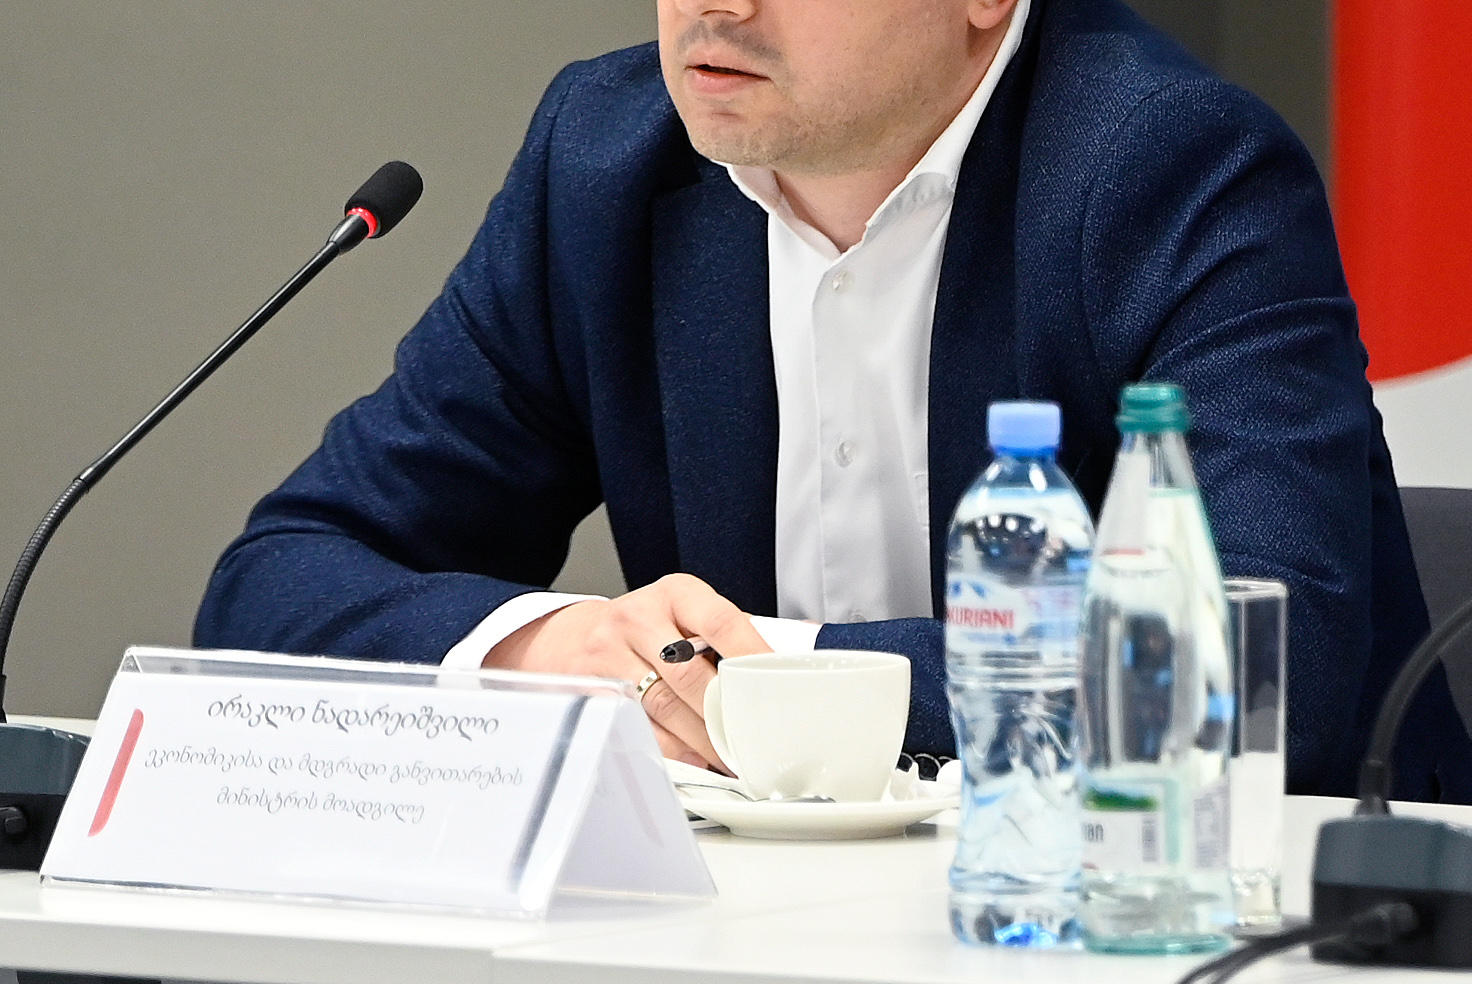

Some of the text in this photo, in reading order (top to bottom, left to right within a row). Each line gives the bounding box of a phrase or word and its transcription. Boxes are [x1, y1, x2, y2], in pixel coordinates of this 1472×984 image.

[208, 694, 499, 742] ირაკლი ნადარეიშვილი
[145, 745, 523, 791] ეკონომიკისა და მდგრადი განვითარების
[216, 785, 425, 824] მინისტრის მოადგილე
